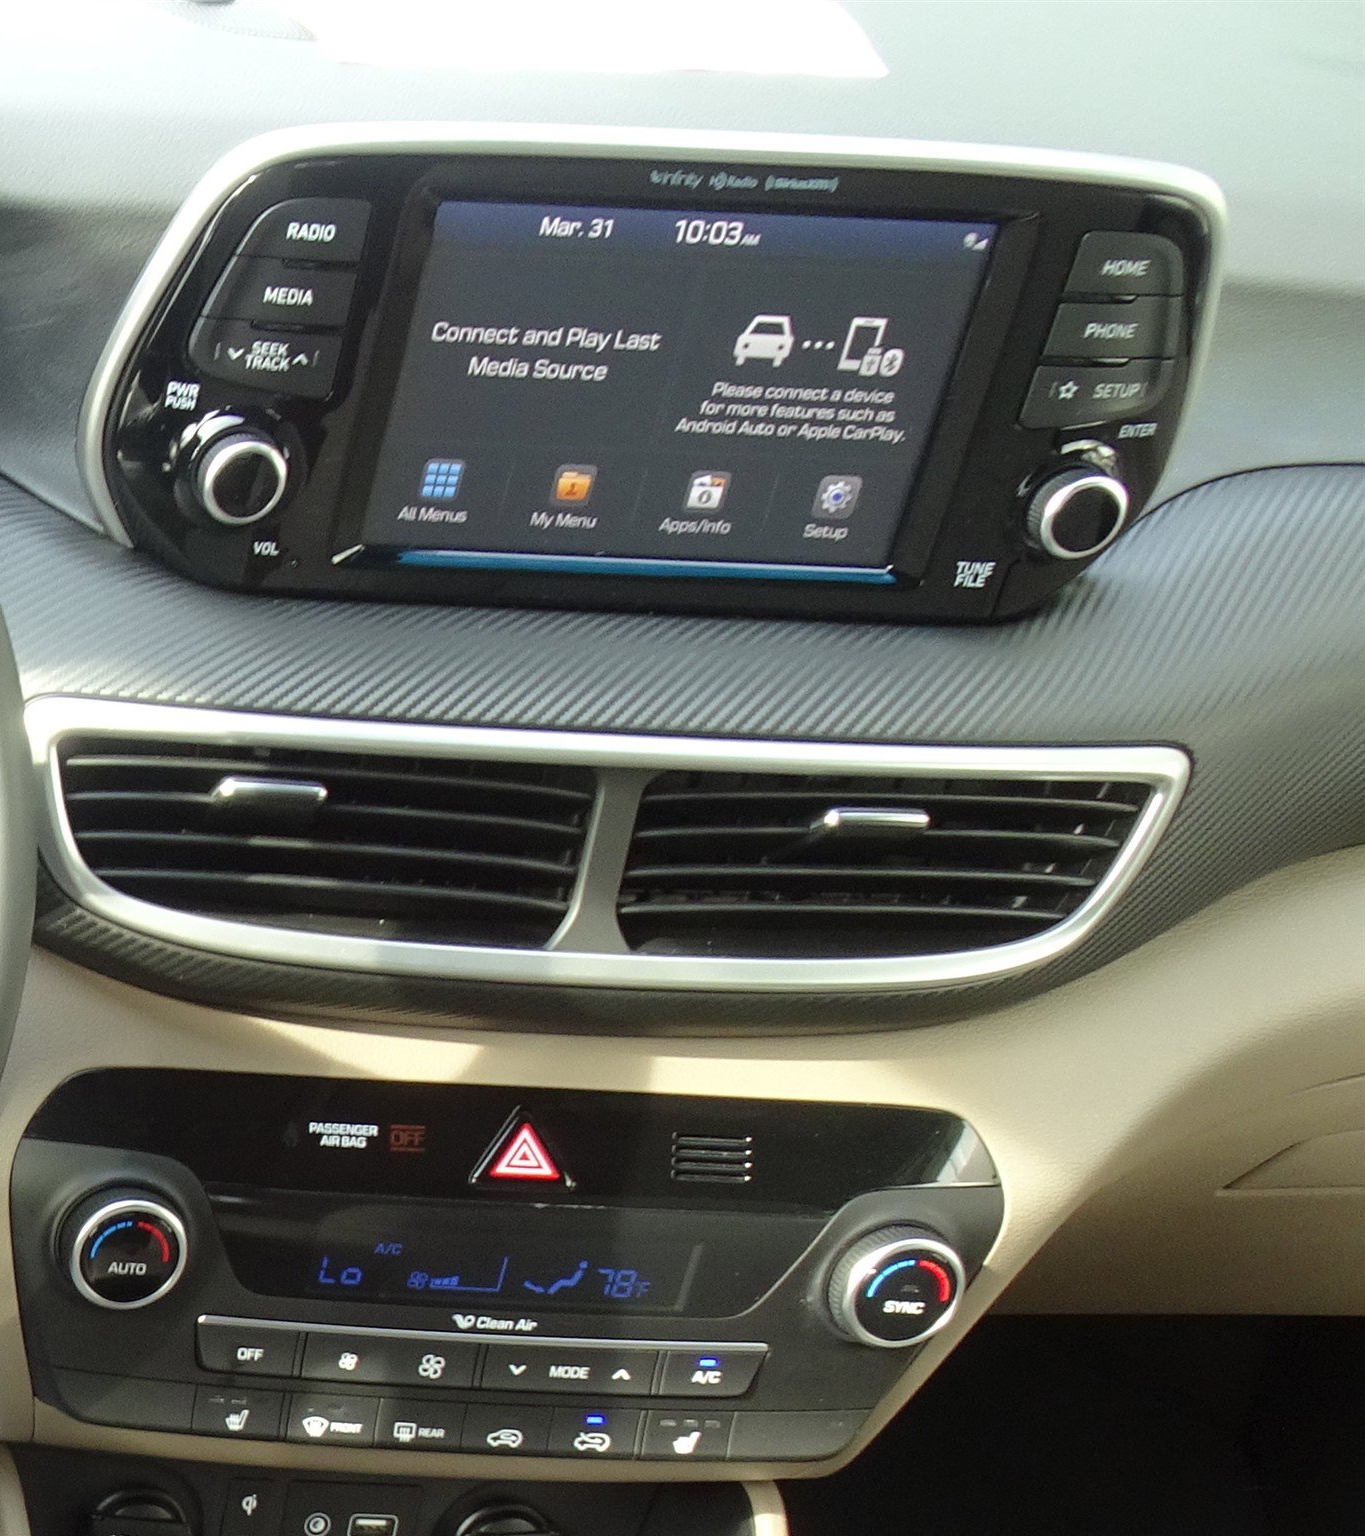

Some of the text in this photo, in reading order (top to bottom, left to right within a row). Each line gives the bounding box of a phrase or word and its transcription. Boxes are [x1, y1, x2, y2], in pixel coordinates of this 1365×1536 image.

[286, 221, 337, 243] RADIO
[539, 216, 615, 238] Mar. 31
[674, 219, 744, 246] 10:03
[1101, 259, 1152, 277] HOME
[262, 286, 313, 307] MEDIA
[431, 321, 662, 352] Connect and Play Last
[1083, 322, 1139, 340] PHONE
[251, 341, 290, 356] SEEK
[245, 355, 290, 372] TRACK
[467, 355, 609, 382] Media Source
[166, 380, 201, 397] PWR
[712, 381, 895, 404] Please connect a device
[1092, 382, 1142, 398] SETUP
[164, 395, 197, 411] PUSH
[699, 399, 895, 422] for more features such as
[675, 416, 906, 444] Android Auto or Apple CarPlay.
[1118, 422, 1158, 439] ENTER
[397, 505, 468, 524] All Menus
[530, 511, 598, 529] My Menu
[803, 523, 849, 543] Setup
[253, 540, 280, 556] VOL
[956, 561, 996, 576] TUNE
[953, 574, 987, 589] FILE
[309, 1122, 378, 1137] PASSENGER
[390, 1130, 425, 1146] OFF
[374, 1242, 403, 1256] A/C
[108, 1261, 147, 1276] AUTO
[882, 1300, 925, 1314] SYNC
[476, 1315, 538, 1332] Clean Air
[237, 1347, 264, 1362] OFF
[549, 1365, 591, 1379] MODE
[691, 1370, 722, 1385] A/C
[330, 1421, 363, 1433] FRONT
[418, 1428, 445, 1439] REAR
